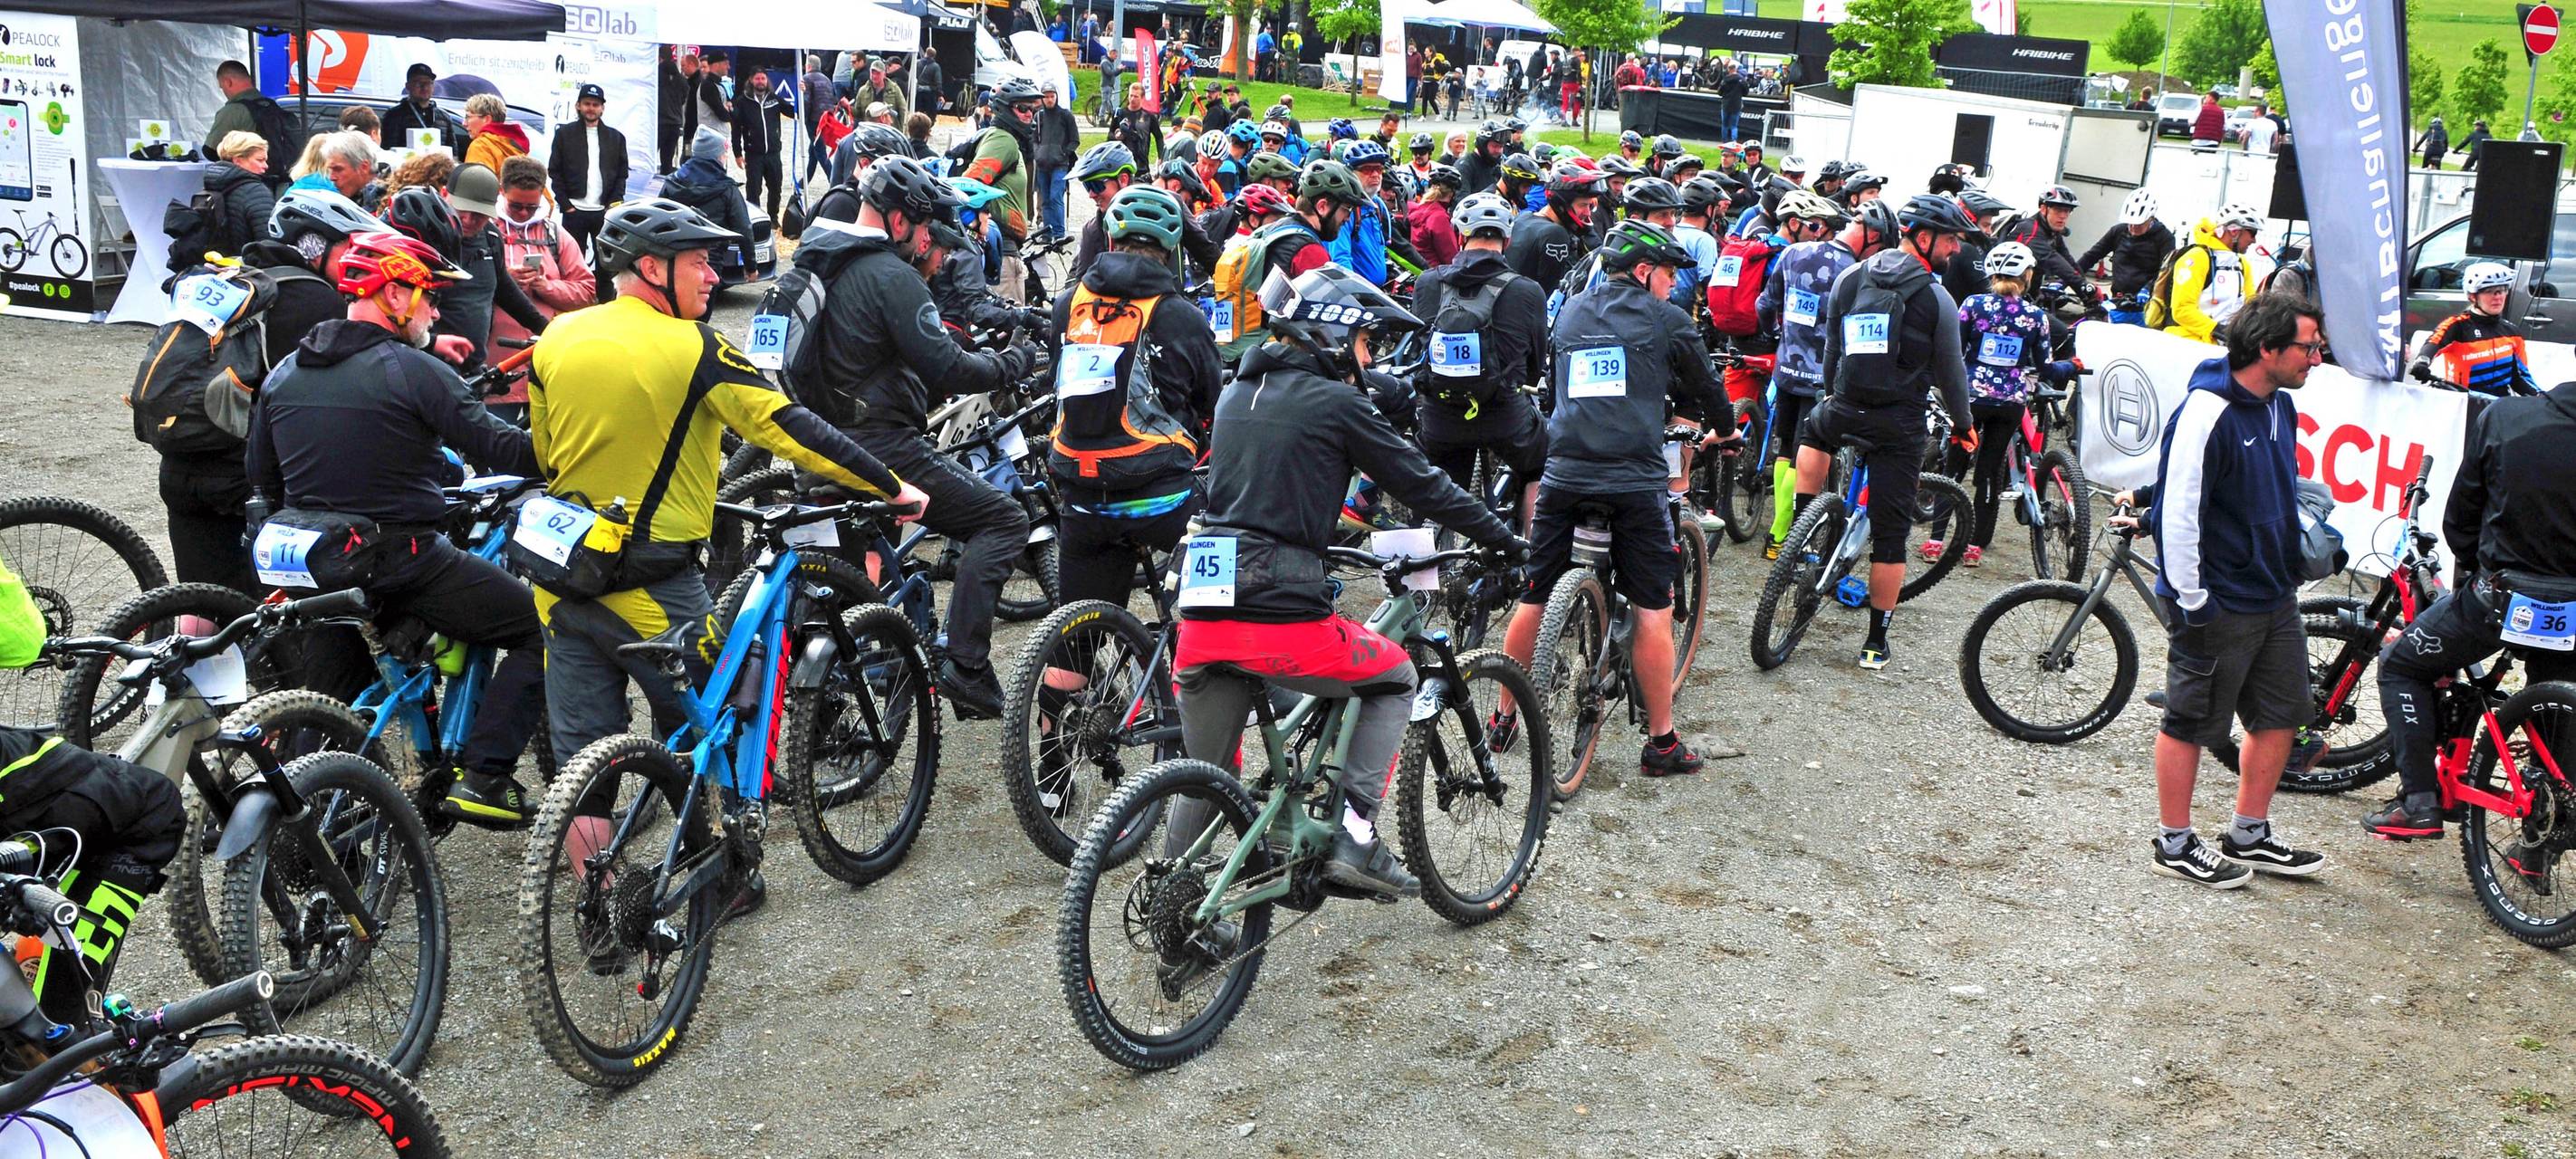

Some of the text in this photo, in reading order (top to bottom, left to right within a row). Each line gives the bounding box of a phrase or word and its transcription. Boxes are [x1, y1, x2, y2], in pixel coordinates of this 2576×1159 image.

[937, 16, 970, 28] FUJI
[12, 31, 61, 47] PEALOCK
[1727, 28, 1785, 40] HAIBIKE
[0, 51, 56, 68] Smart lock
[448, 53, 486, 66] Endlich
[2012, 48, 2075, 61] HAIBIKE
[1722, 263, 1734, 273] 46
[9, 281, 40, 292] #pealock
[196, 285, 225, 307] 93
[1796, 298, 1815, 312] 149
[1216, 311, 1229, 325] 122
[1306, 302, 1383, 330] 100%
[754, 328, 779, 347] 165
[1860, 323, 1883, 337] 114
[1453, 345, 1470, 359] 18
[1997, 342, 2017, 356] 112
[1088, 355, 1101, 372] 2
[1591, 359, 1620, 376] 139
[1780, 365, 1823, 380] TRIPLE EIGHT
[547, 512, 577, 535] 62
[280, 542, 298, 564] 11
[1195, 555, 1220, 578] 45
[2530, 601, 2566, 612] WILLINGEN
[1062, 611, 1101, 636] MAXXIS
[2541, 615, 2567, 632] 36
[2398, 693, 2419, 724] FOX
[377, 830, 388, 876] DT SWISS
[633, 1027, 677, 1068] MAXXIS
[324, 1068, 397, 1108] MAGIC
